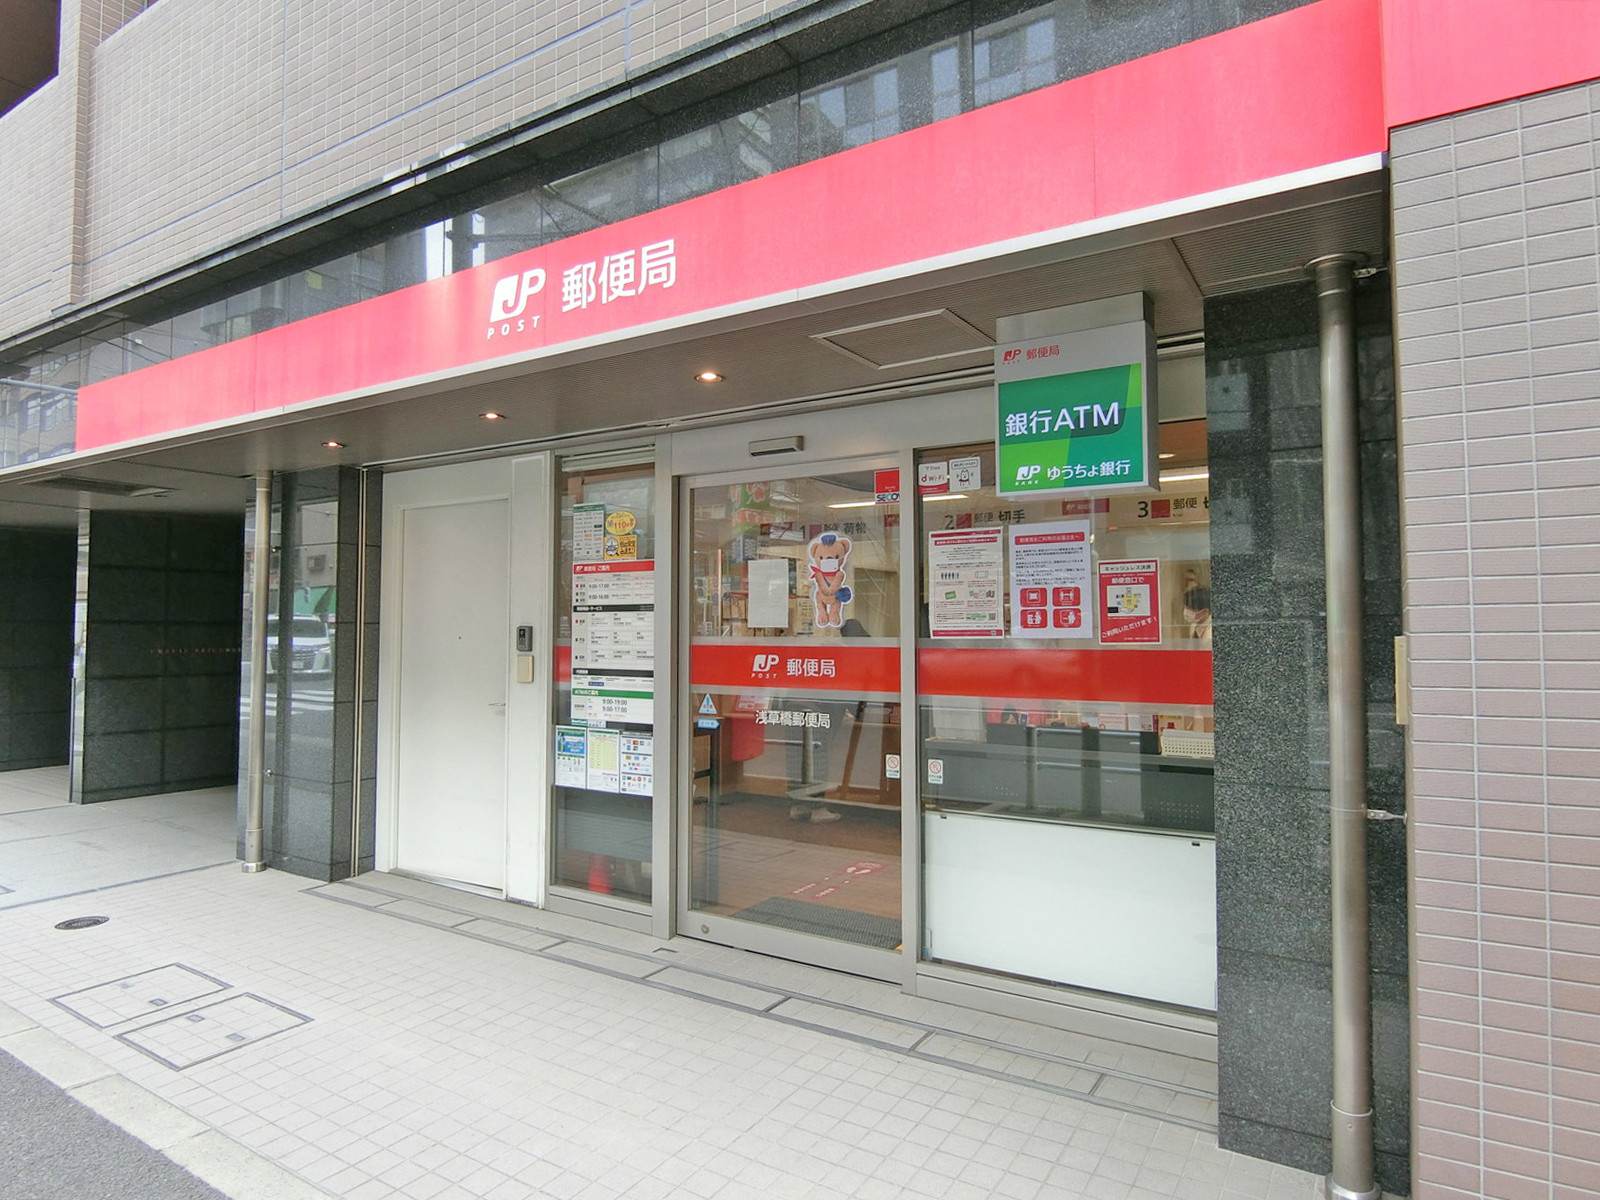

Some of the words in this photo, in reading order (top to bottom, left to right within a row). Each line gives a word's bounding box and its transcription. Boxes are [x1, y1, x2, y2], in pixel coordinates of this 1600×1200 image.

[561, 238, 677, 313] 郵便局
[487, 315, 541, 339] POST
[1026, 344, 1060, 360] 郵便局
[1005, 401, 1120, 437] 銀行ATM
[1047, 459, 1131, 481] ゆうちょ銀行
[1137, 501, 1149, 518] 3
[1173, 497, 1198, 509] 郵便
[843, 522, 867, 535] 荷物
[944, 514, 955, 529] 2
[998, 509, 1025, 524] 切手
[786, 658, 836, 677] 郵便局
[755, 709, 831, 729] 浅草橋郵便局
